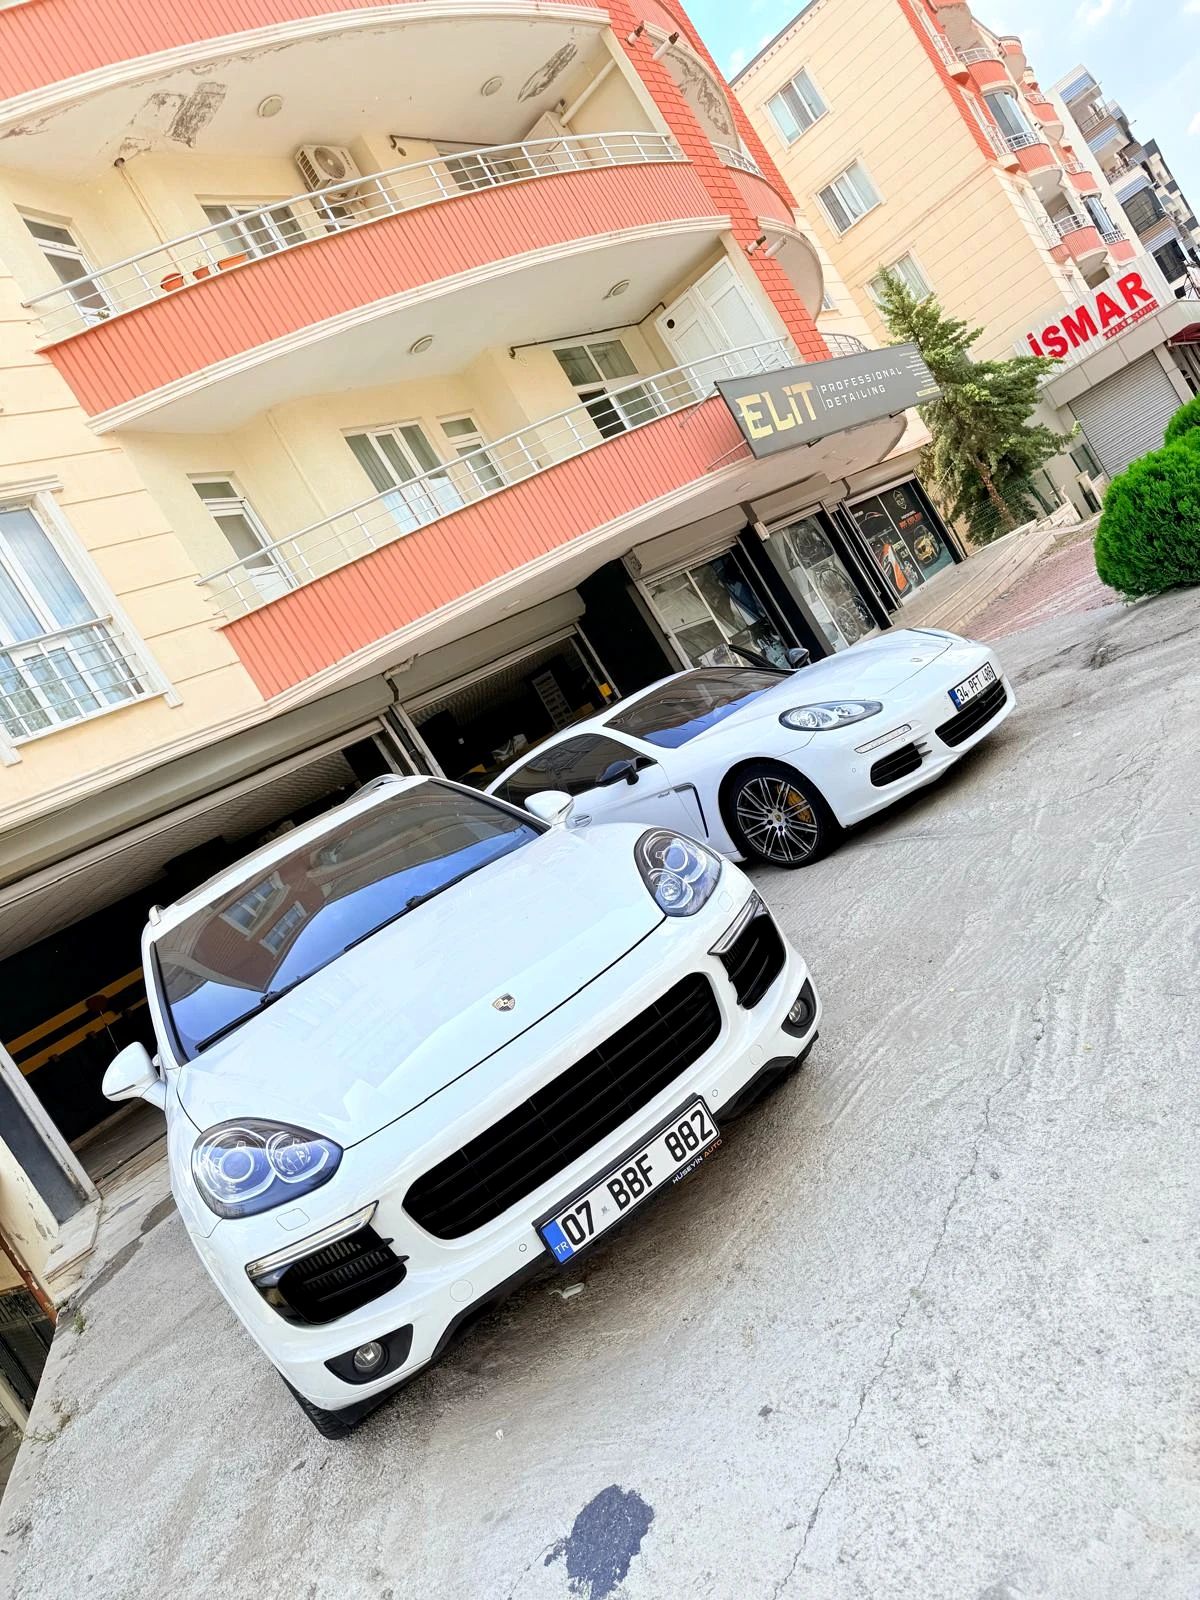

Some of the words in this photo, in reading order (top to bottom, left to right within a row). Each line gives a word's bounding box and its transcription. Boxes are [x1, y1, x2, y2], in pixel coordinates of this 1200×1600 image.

[820, 367, 902, 394] PROFESSIONAL
[825, 386, 886, 409] DETAILING
[957, 686, 969, 701] 34
[968, 674, 982, 694] PFT
[664, 1109, 714, 1163] 882
[704, 1139, 723, 1158] AUTO
[606, 1153, 653, 1211] BBF
[561, 1200, 595, 1246] 07
[554, 1241, 569, 1255] TR
